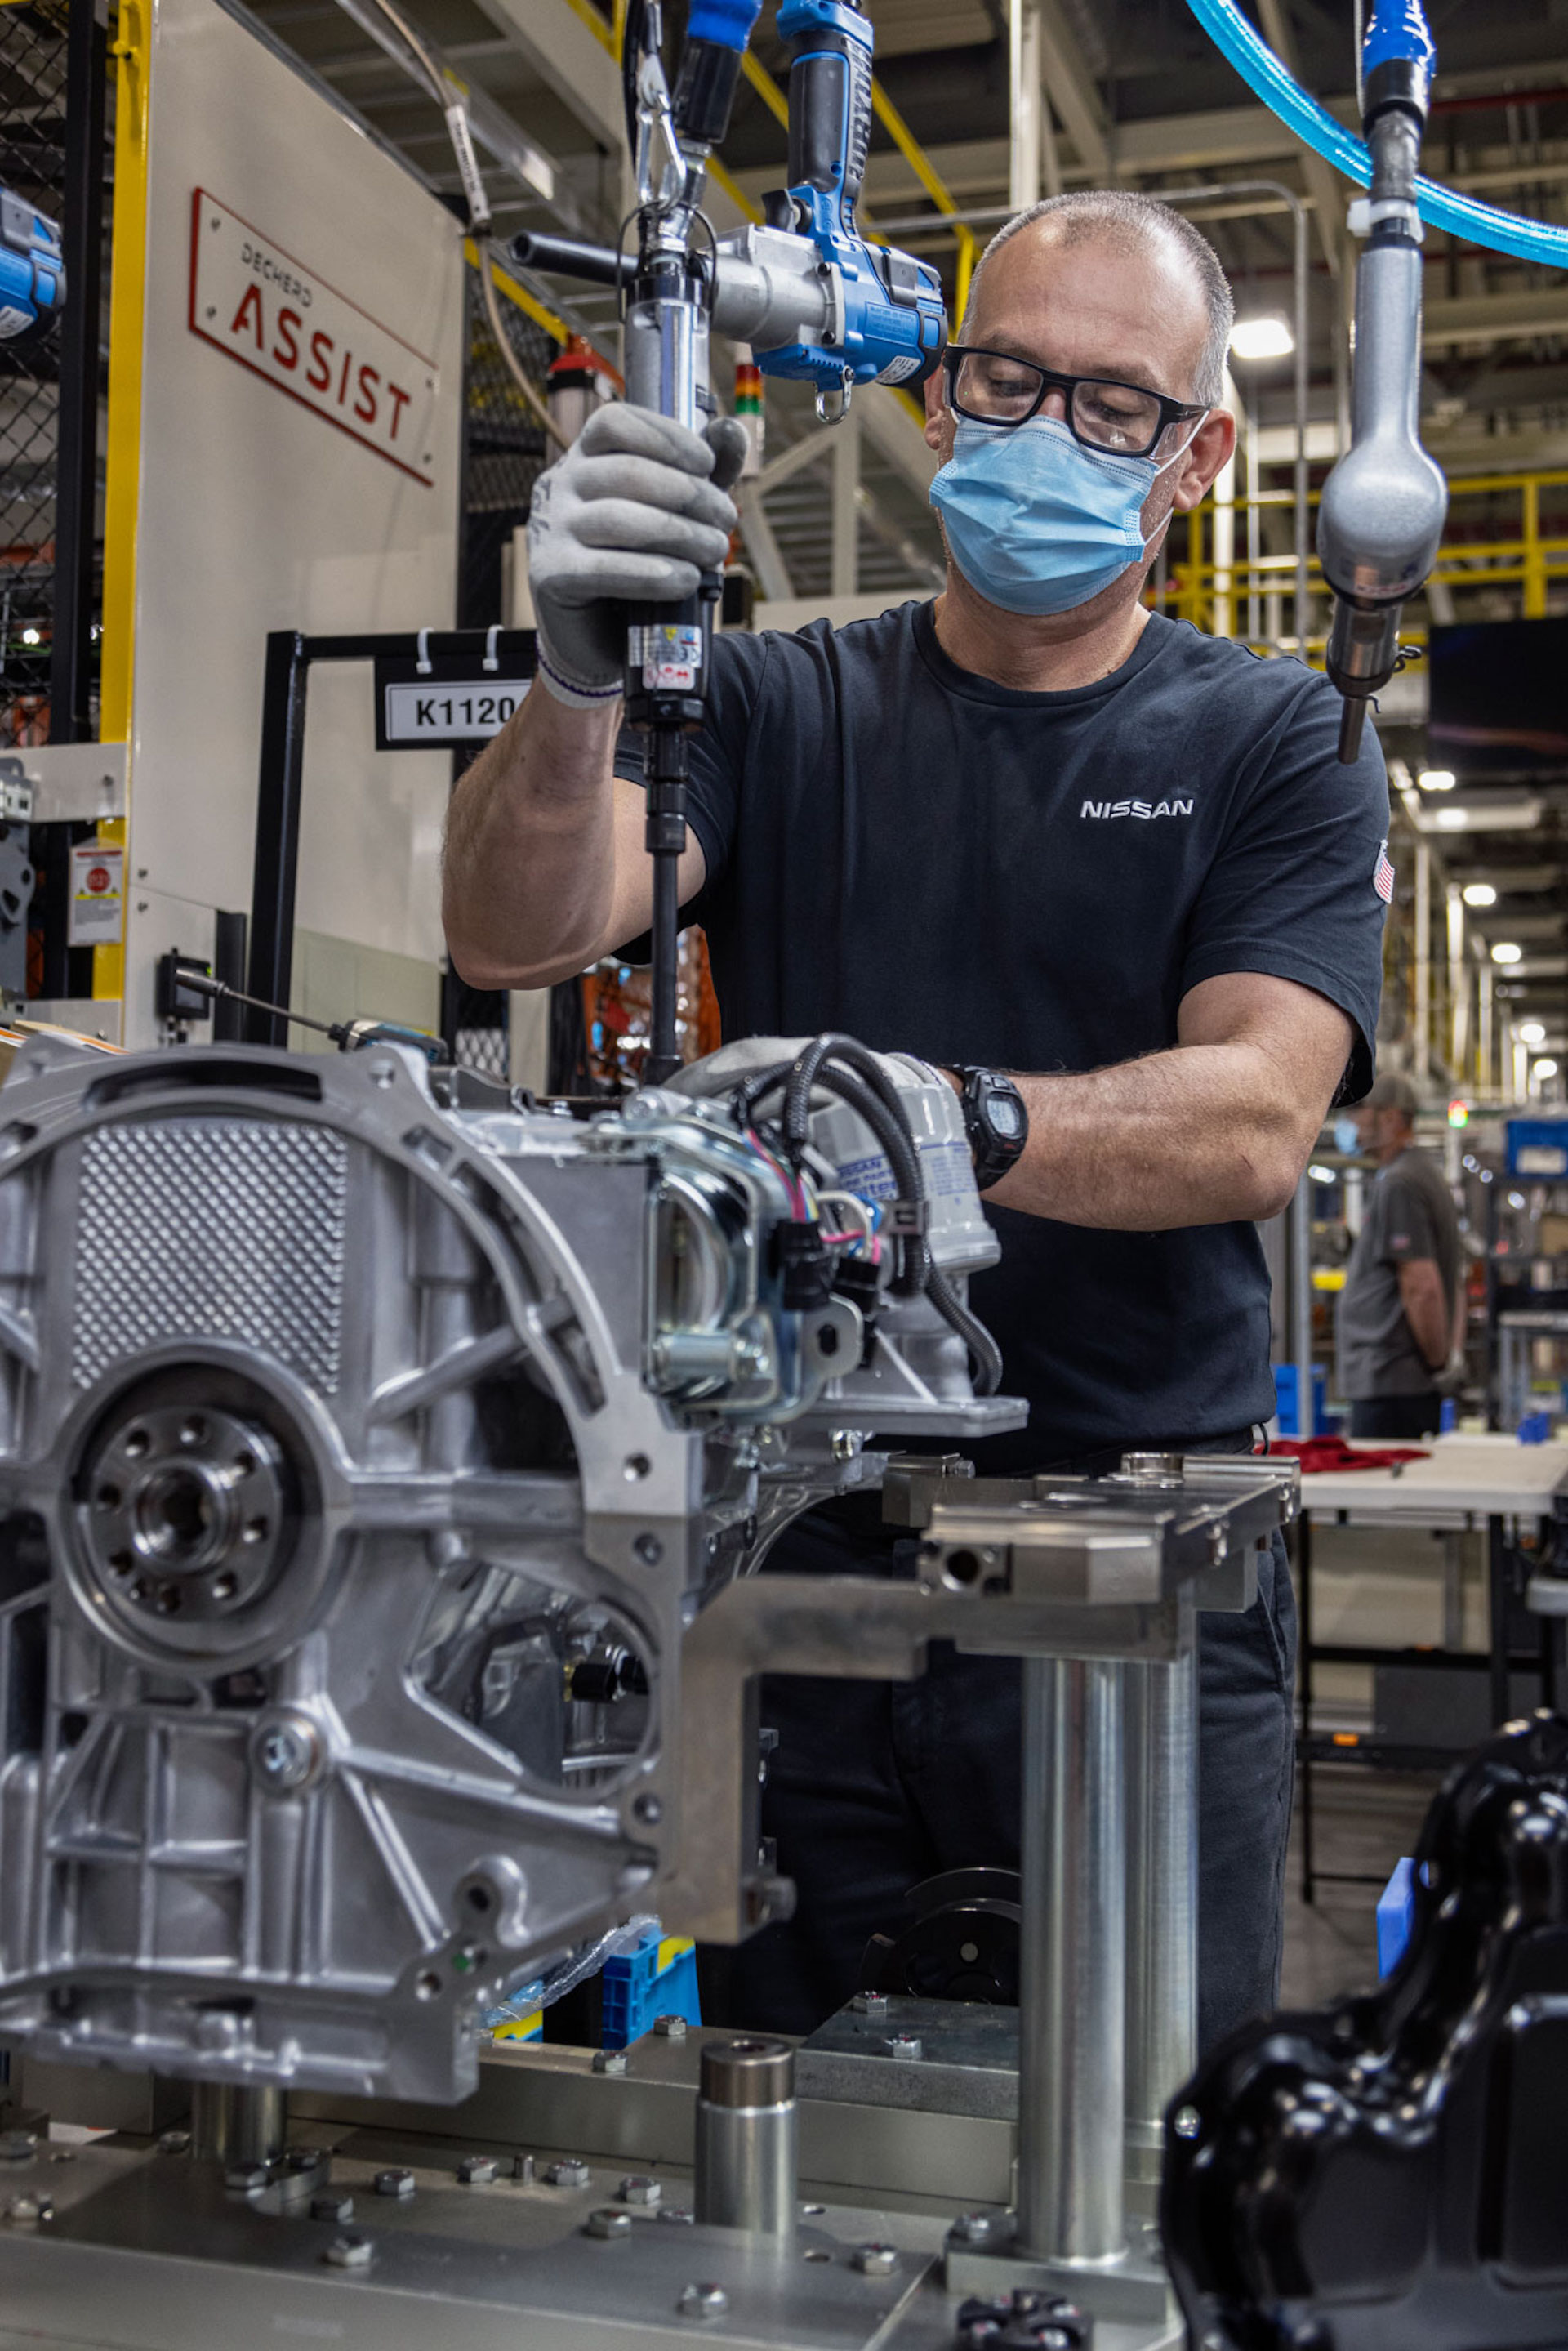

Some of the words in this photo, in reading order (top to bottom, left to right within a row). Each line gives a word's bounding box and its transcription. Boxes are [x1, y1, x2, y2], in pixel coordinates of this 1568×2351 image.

[241, 243, 313, 308] DECHERD
[230, 283, 412, 441] ASSIST
[416, 696, 515, 726] K1120
[1080, 798, 1194, 819] NISSAN
